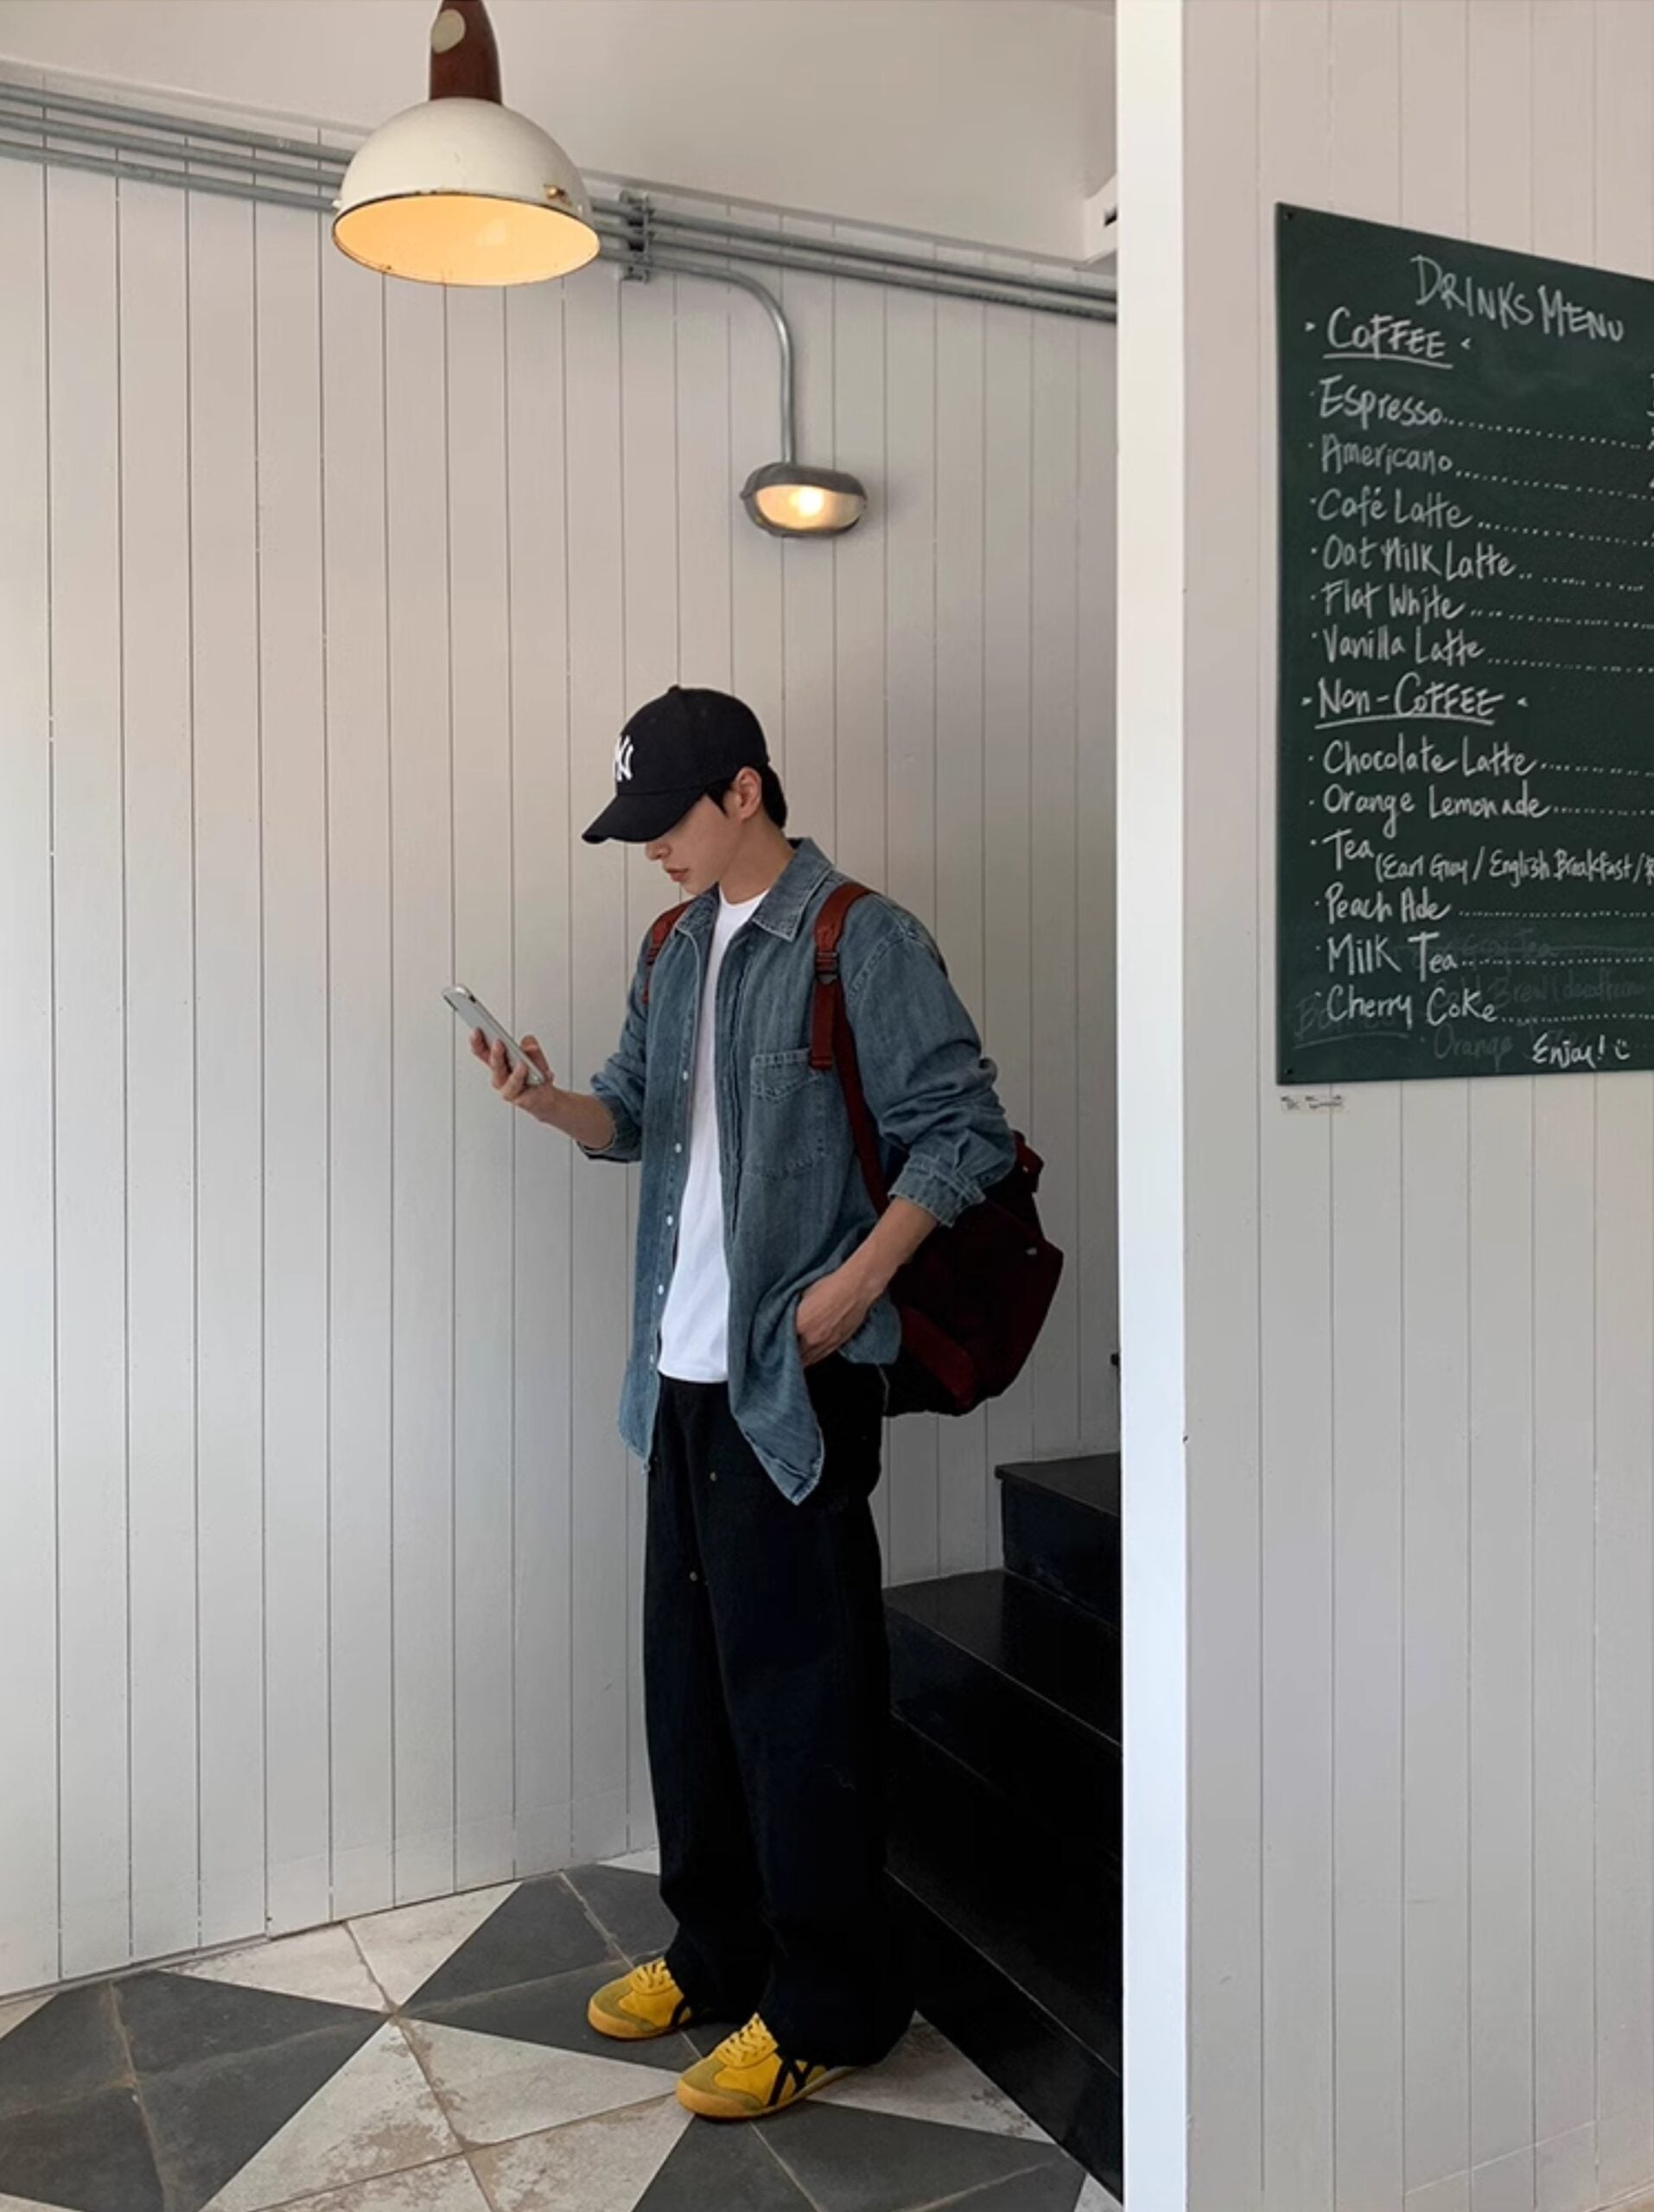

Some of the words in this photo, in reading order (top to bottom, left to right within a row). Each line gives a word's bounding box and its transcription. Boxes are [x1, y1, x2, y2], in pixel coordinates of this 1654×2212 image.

[1409, 254, 1535, 329] DRINKS
[1537, 284, 1625, 342] MENU
[1319, 374, 1444, 430] Espresso
[1321, 433, 1454, 475] Americano
[1317, 485, 1386, 527] Café
[1395, 488, 1473, 529] Latte
[1323, 534, 1377, 570] Oat
[1446, 540, 1517, 582] Latte
[1320, 579, 1382, 619] Flat
[1389, 582, 1466, 625] White
[1322, 624, 1406, 664] Vanilla
[1415, 626, 1486, 667] Latte
[1322, 732, 1459, 776] Chocolate
[1462, 735, 1537, 777] Latte
[1323, 783, 1415, 838] Orange
[1428, 779, 1552, 819] Lemonade
[1322, 829, 1375, 871] Tea
[1325, 881, 1392, 925] Peach
[1400, 887, 1453, 924] Ade
[1407, 931, 1459, 982] Tea
[1326, 984, 1413, 1029] Cherry
[1426, 987, 1498, 1027] Coke
